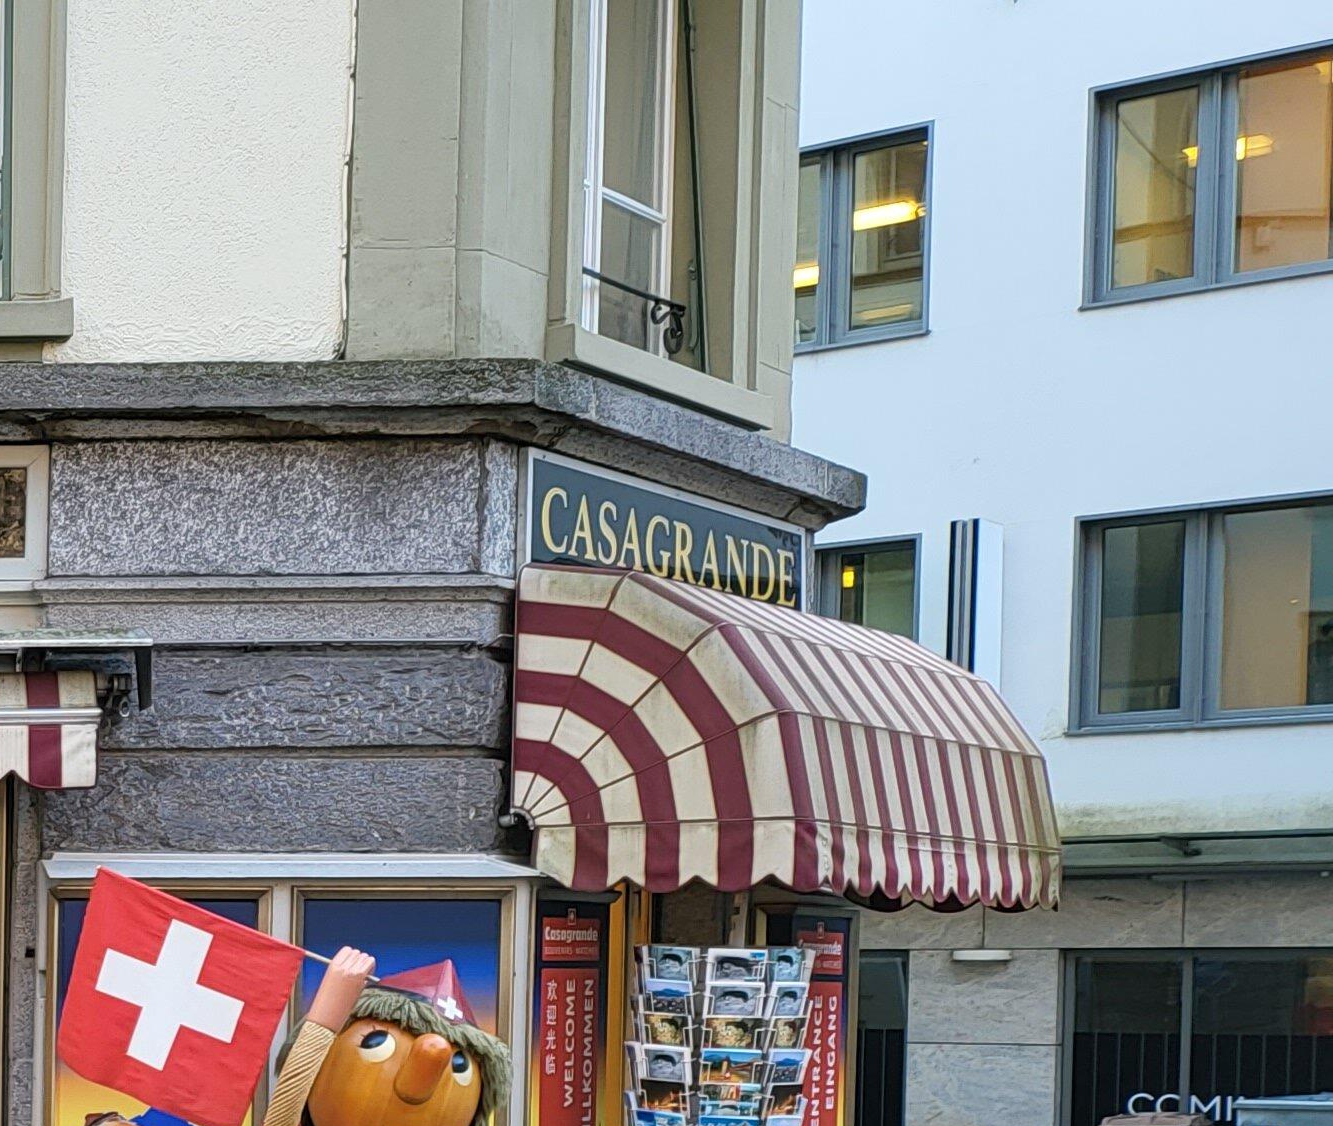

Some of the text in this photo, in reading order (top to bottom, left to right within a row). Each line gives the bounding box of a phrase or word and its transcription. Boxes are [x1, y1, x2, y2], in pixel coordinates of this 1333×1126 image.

[541, 487, 796, 607] CASAGRANDE
[545, 926, 598, 943] Casagrande
[545, 979, 557, 1076] 欢迎光临
[563, 978, 576, 1108] WELCOME
[825, 996, 837, 1110] EINGANG
